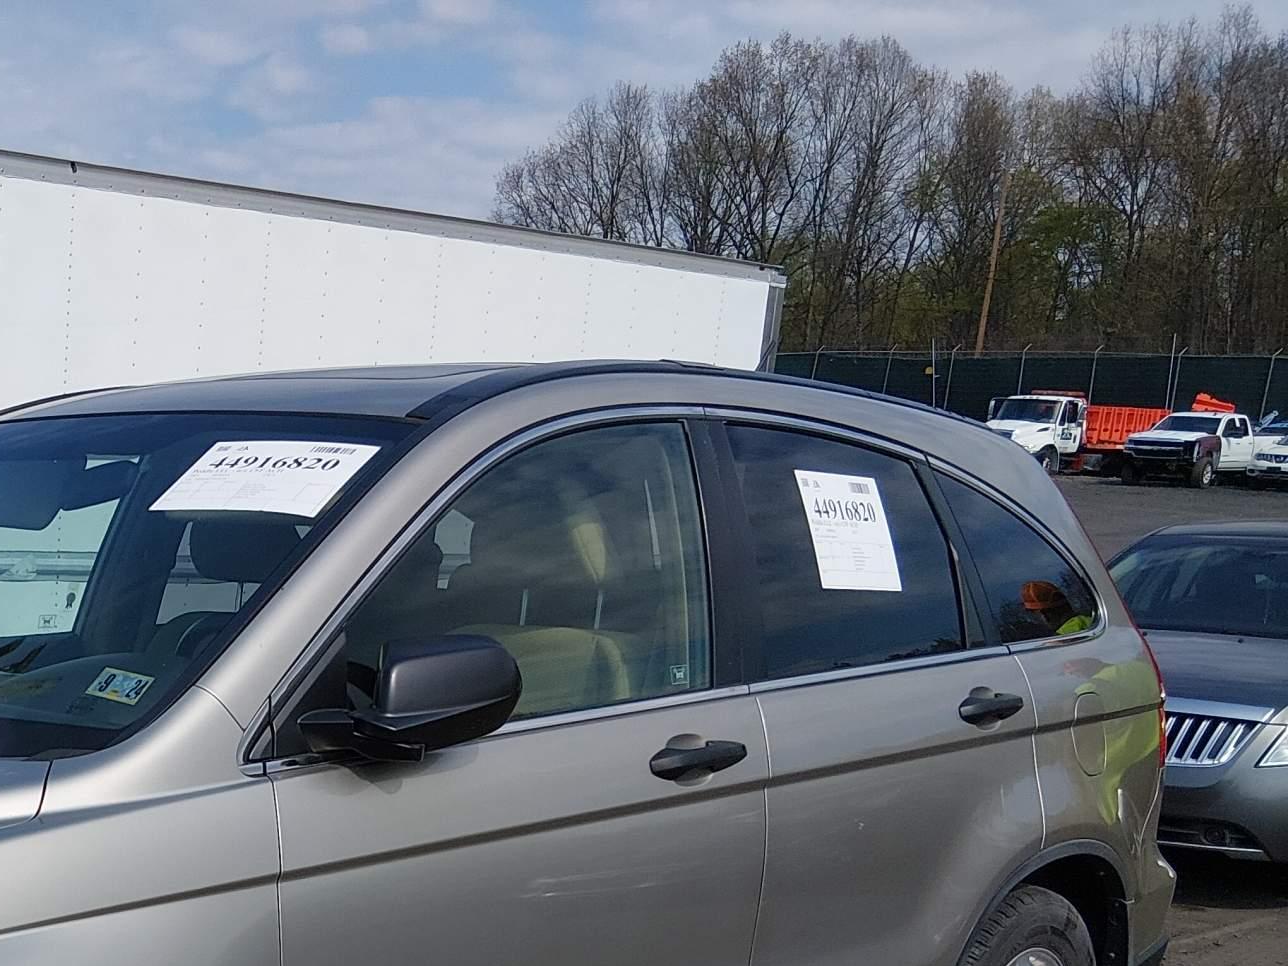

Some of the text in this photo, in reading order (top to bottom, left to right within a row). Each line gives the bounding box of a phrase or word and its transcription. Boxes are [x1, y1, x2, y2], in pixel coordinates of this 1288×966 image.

[208, 455, 341, 471] 44916820
[813, 497, 876, 522] 44916820
[125, 679, 150, 699] 24
